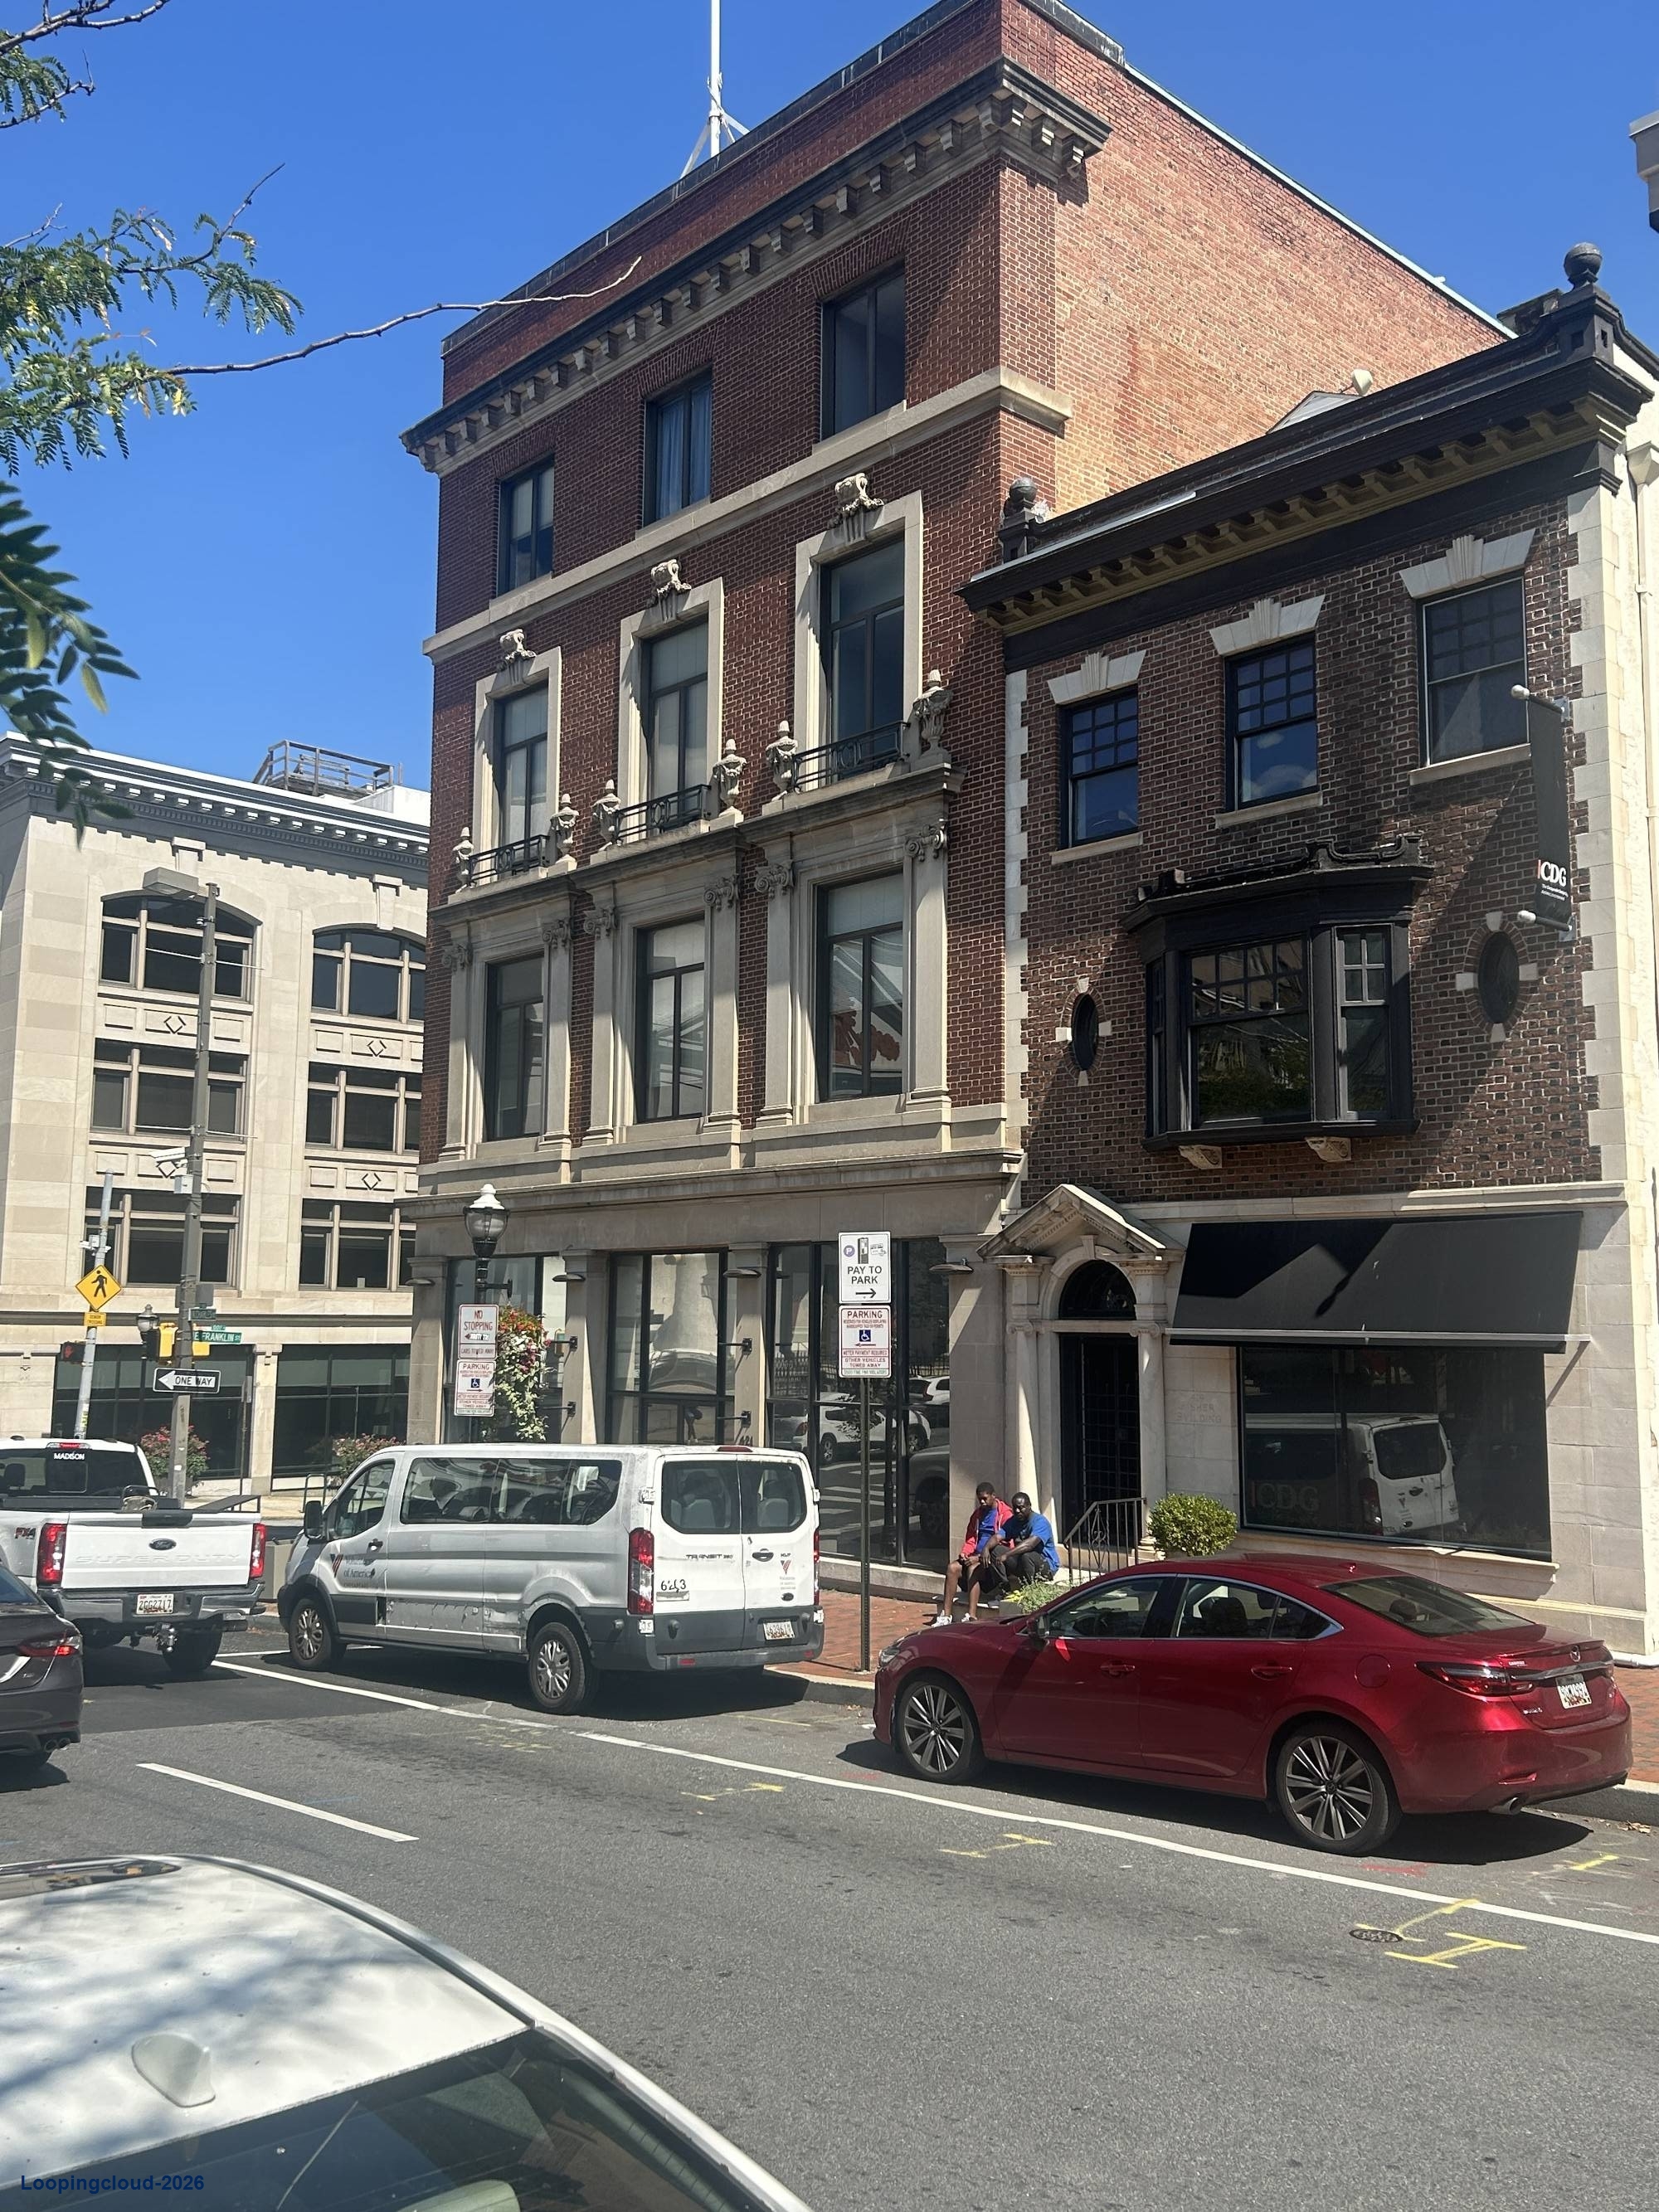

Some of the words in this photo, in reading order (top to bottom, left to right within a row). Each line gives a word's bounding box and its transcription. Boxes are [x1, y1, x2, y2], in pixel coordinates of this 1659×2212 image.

[1540, 861, 1567, 887] CDG
[847, 1266, 866, 1275] PAY
[868, 1265, 883, 1274] TO
[851, 1276, 878, 1285] PARK
[474, 1310, 484, 1320] NO
[847, 1310, 883, 1319] PARKING
[465, 1321, 494, 1331] STOPPING
[194, 1331, 199, 1340] E
[202, 1331, 235, 1342] FRANKLIN
[175, 1376, 192, 1385] ONE
[196, 1377, 212, 1386] WAY
[53, 1452, 85, 1461] MADISON
[75, 1554, 169, 1564] SUPER
[175, 1553, 241, 1563] DUTY
